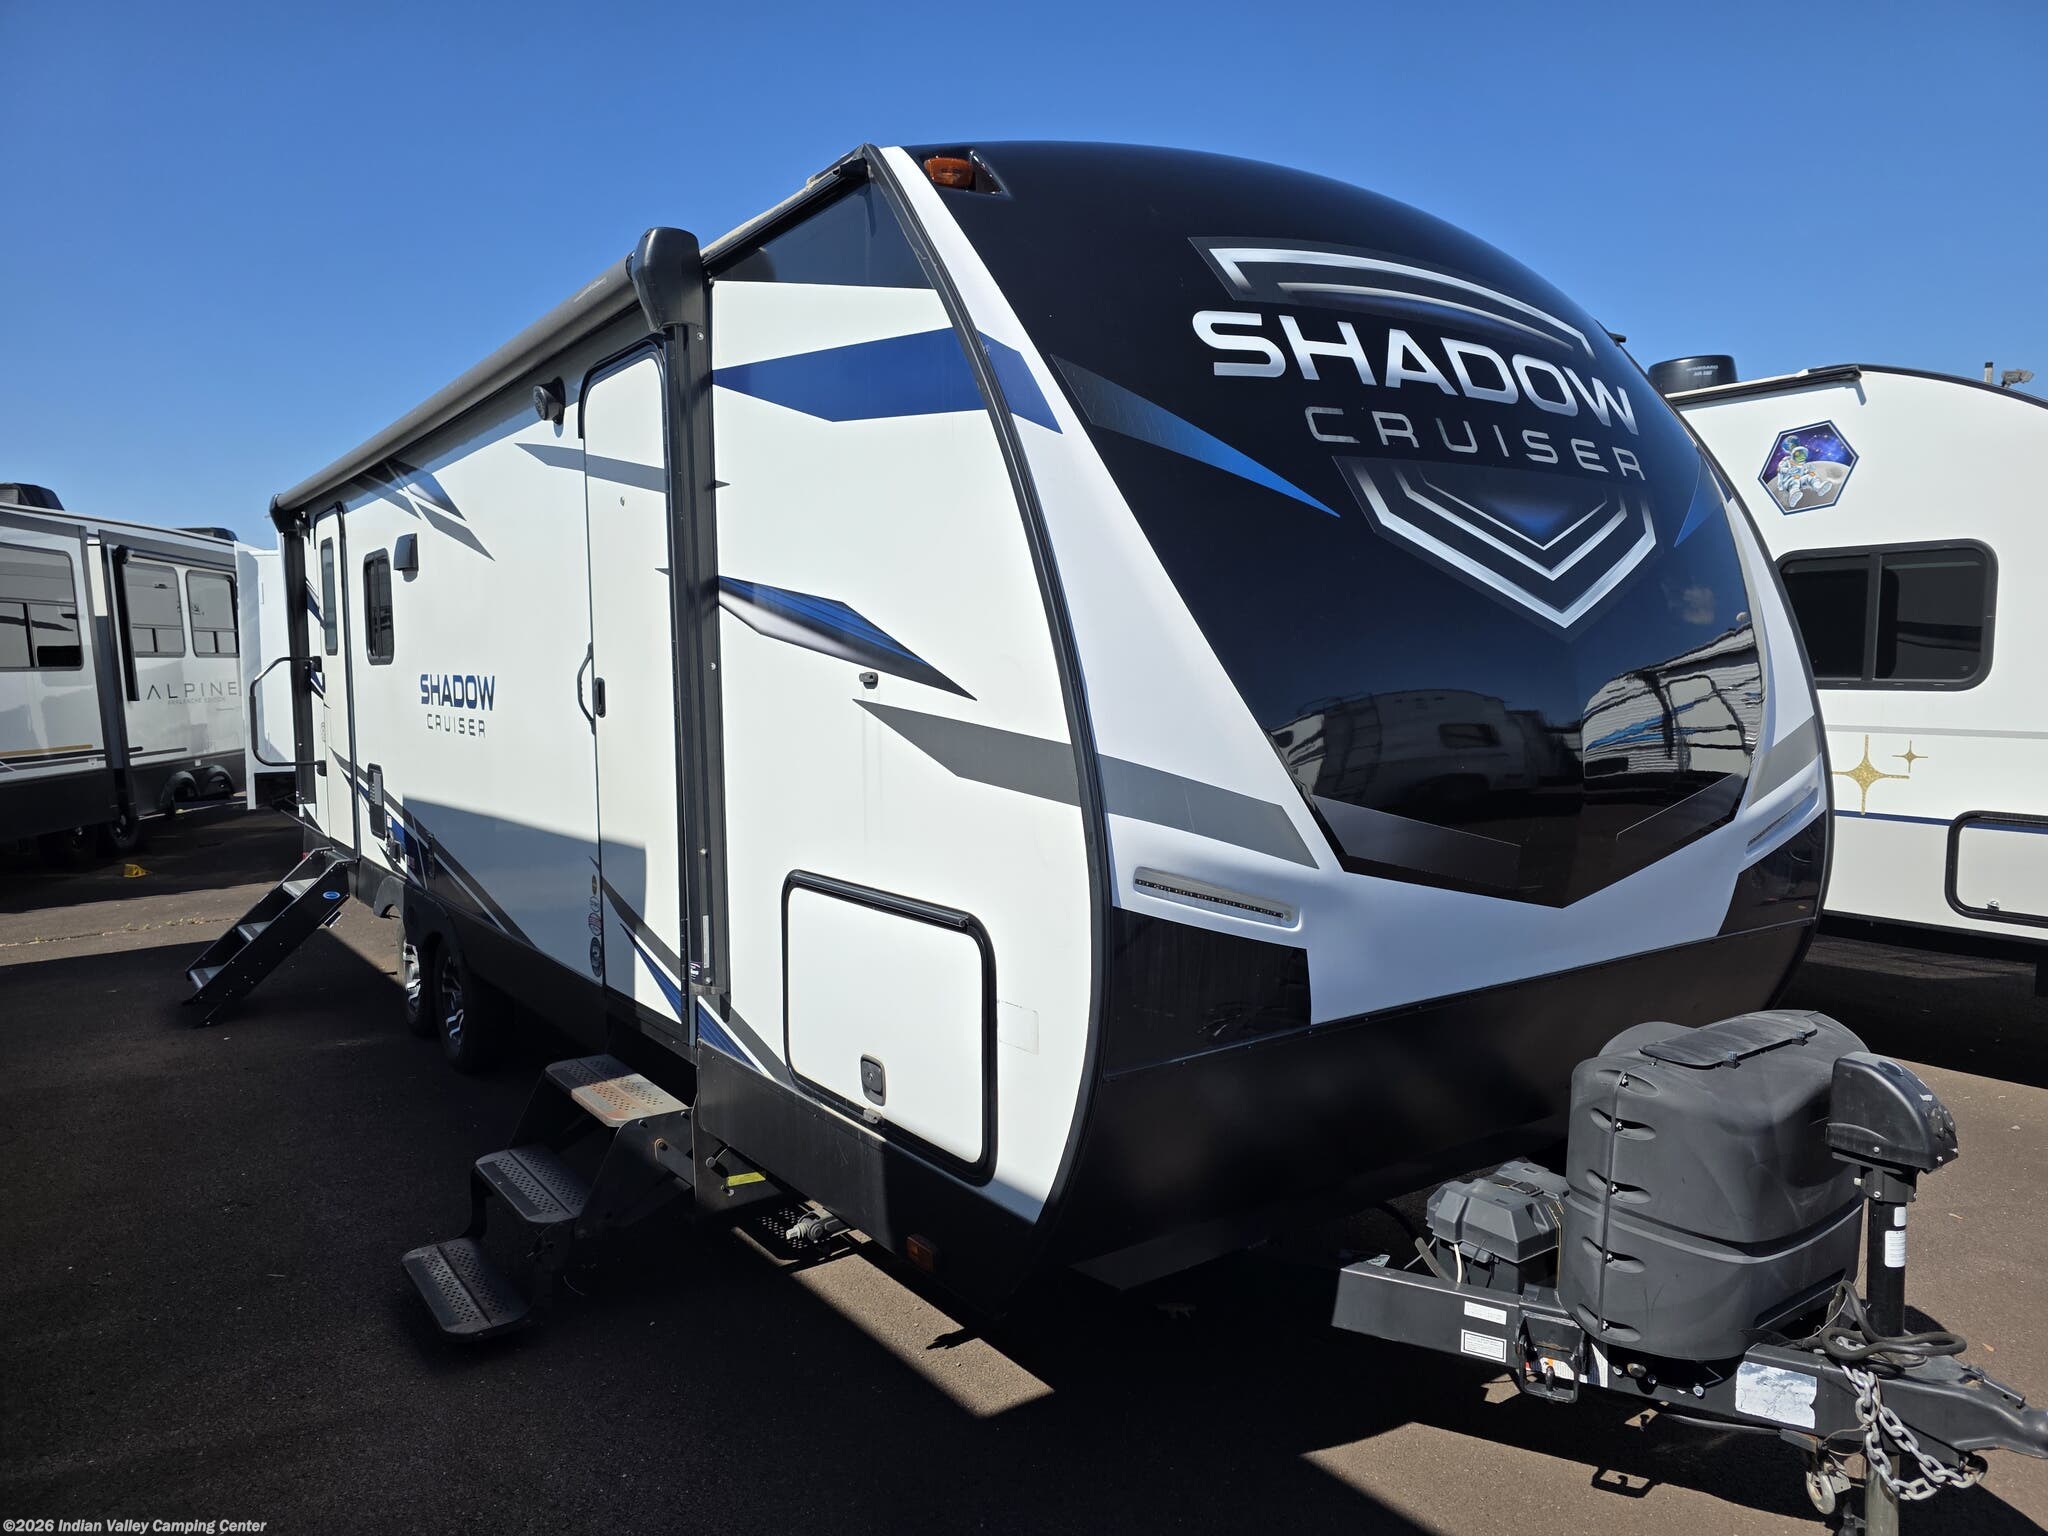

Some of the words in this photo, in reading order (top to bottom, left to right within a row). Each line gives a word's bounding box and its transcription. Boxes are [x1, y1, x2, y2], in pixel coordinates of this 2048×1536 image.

[1192, 310, 1639, 435] SHADOW
[1304, 406, 1646, 480] CRUISER
[147, 681, 238, 700] ALPINE
[420, 674, 495, 711] SHADOW
[427, 713, 486, 738] CRUISER
